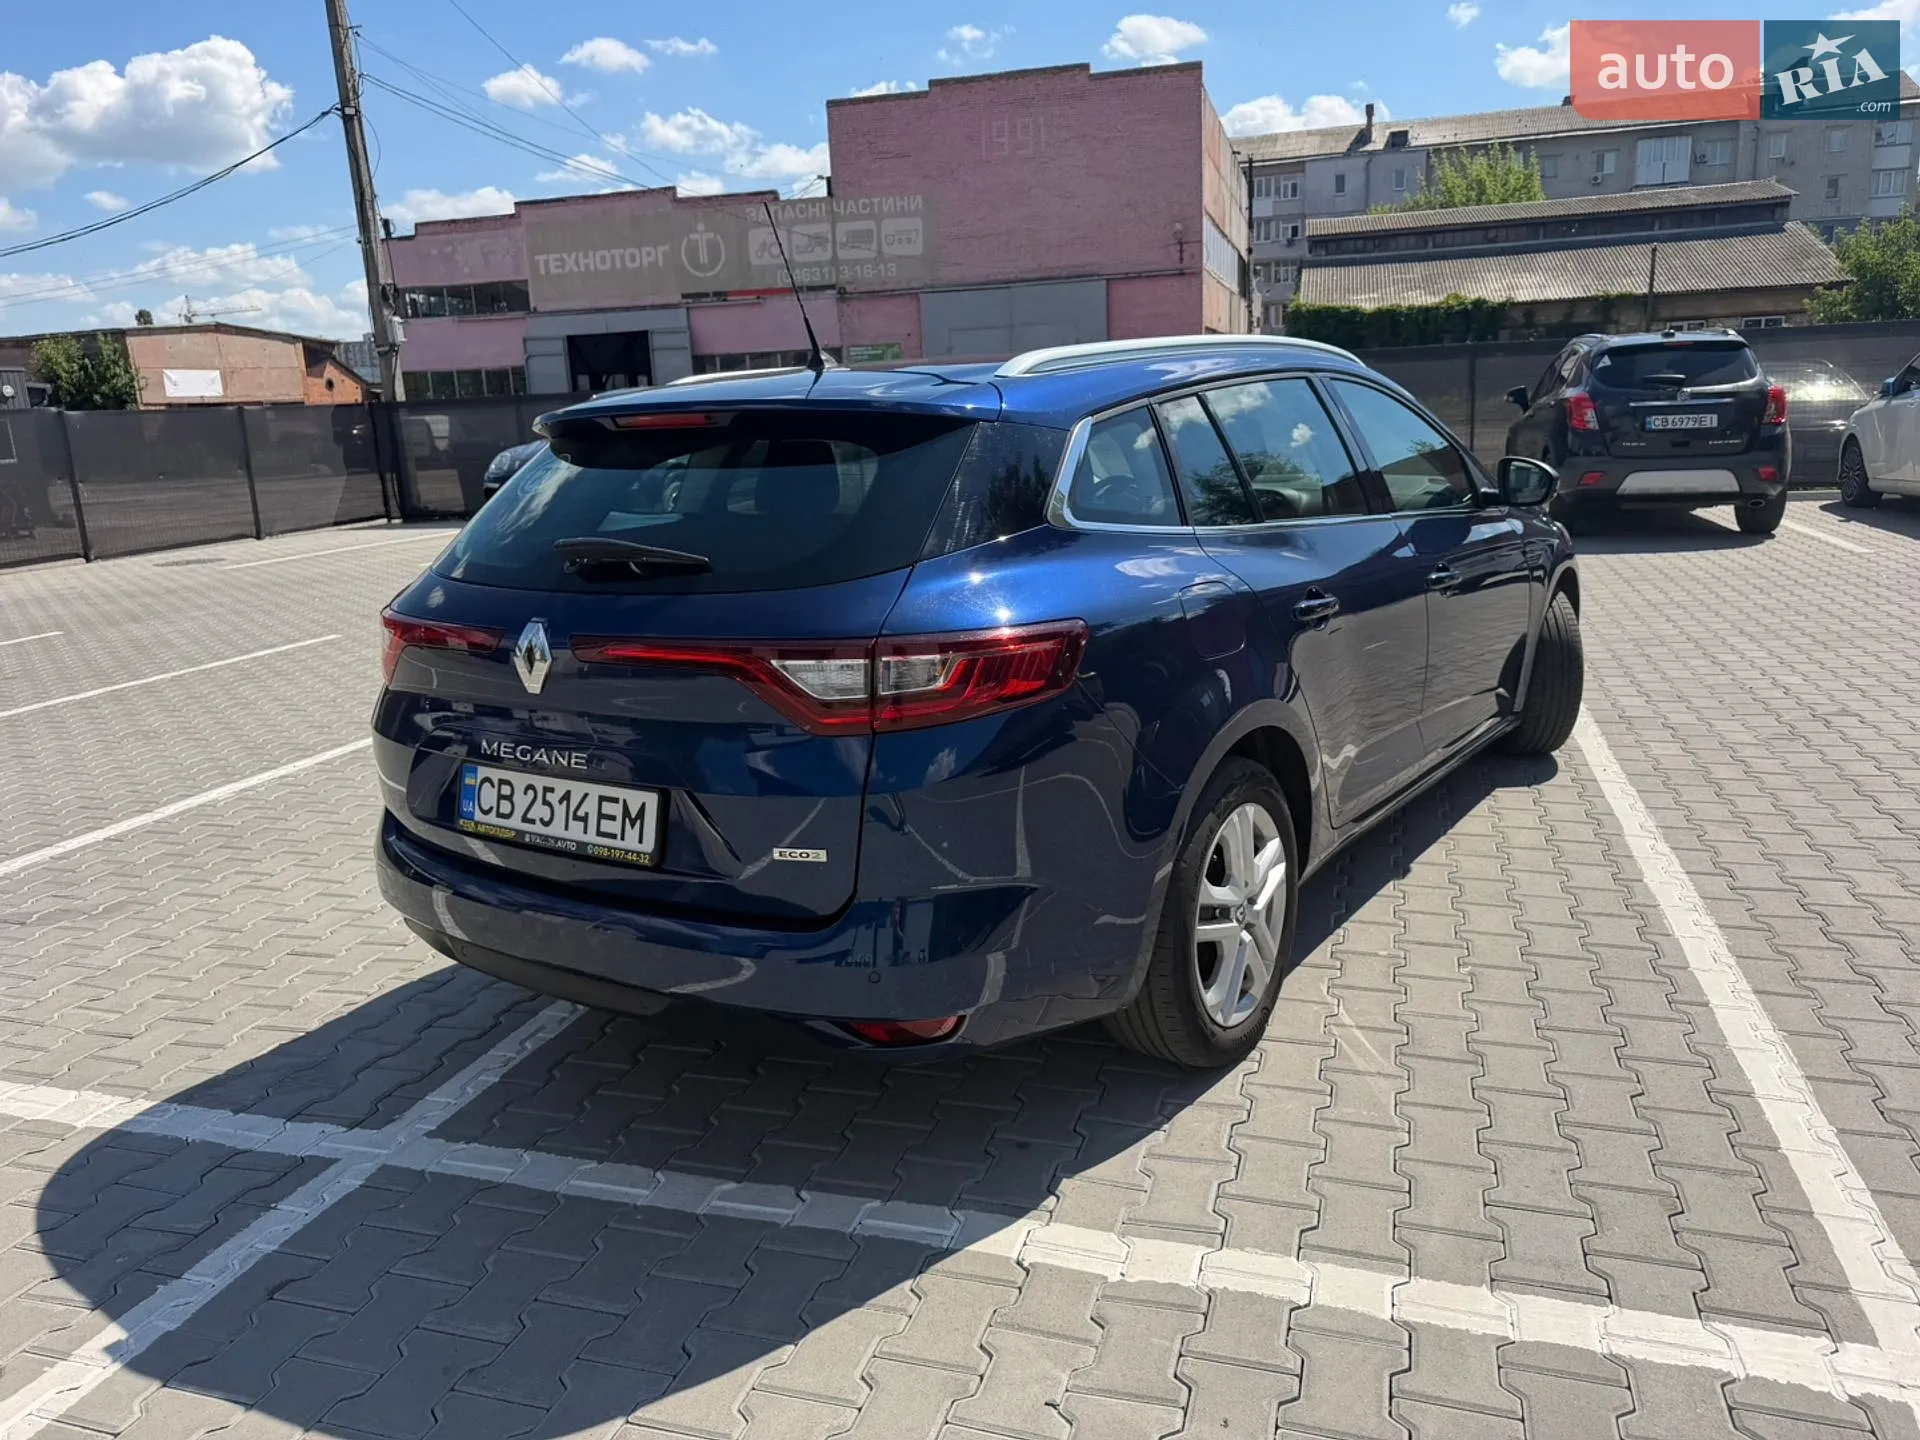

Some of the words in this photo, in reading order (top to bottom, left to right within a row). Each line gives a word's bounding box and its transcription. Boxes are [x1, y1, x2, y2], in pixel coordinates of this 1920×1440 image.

[744, 202, 827, 222] ЗАПАСНІ
[833, 195, 923, 217] ЧАСТИНИ
[534, 244, 670, 276] ТЕХНОТОРГ
[480, 739, 589, 770] MEGANE
[462, 799, 474, 813] UA
[521, 783, 590, 836] 2514
